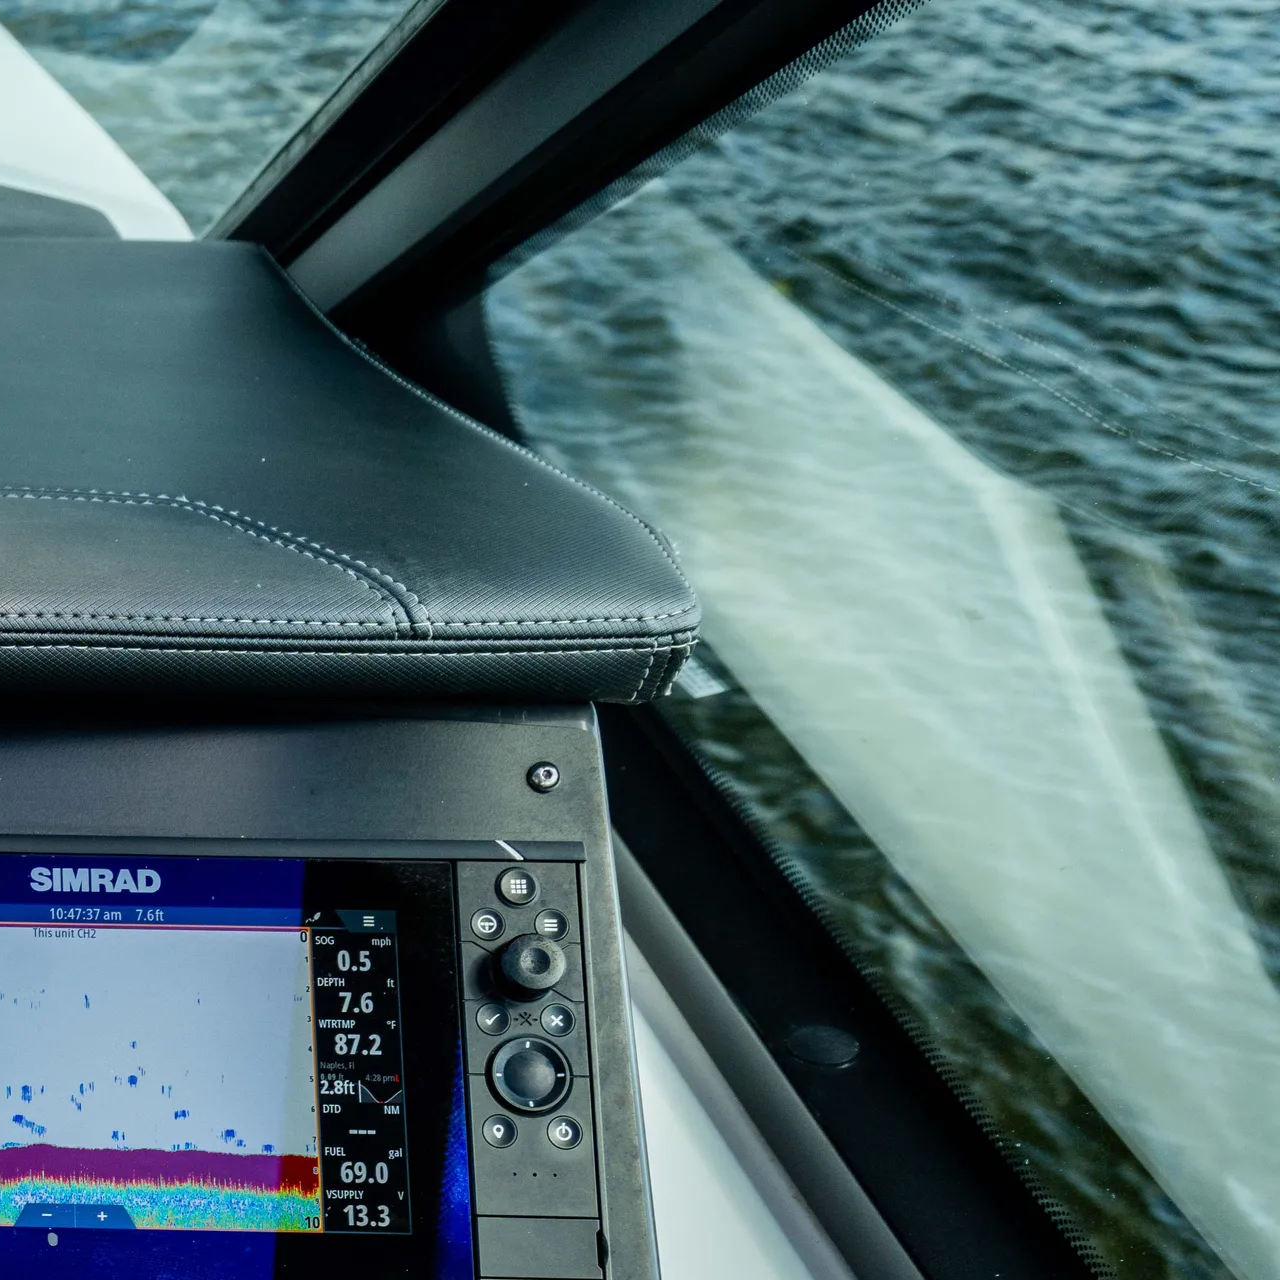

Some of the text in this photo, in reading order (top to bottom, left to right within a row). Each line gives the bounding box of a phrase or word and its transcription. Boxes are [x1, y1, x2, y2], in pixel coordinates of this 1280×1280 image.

[30, 866, 161, 893] SIMRAD
[49, 908, 100, 921] 10:47:37
[103, 910, 122, 921] am
[33, 927, 97, 939] This unit CH2
[315, 936, 392, 948] SOG mph
[337, 950, 372, 972] 0.5
[317, 977, 395, 988] DEPTH ft
[339, 992, 374, 1014] 7.6
[318, 1019, 397, 1029] WTRTMP °F
[334, 1033, 382, 1056] 87.2
[365, 1074, 382, 1082] 4:28
[320, 1080, 355, 1095] 2.8ft
[323, 1104, 400, 1115] DTD NM
[324, 1147, 402, 1159] FUEL gal
[340, 1161, 389, 1184] 69.0
[326, 1190, 404, 1200] VSUPPLY V
[305, 1216, 320, 1229] 10
[343, 1205, 390, 1227] 13.3
